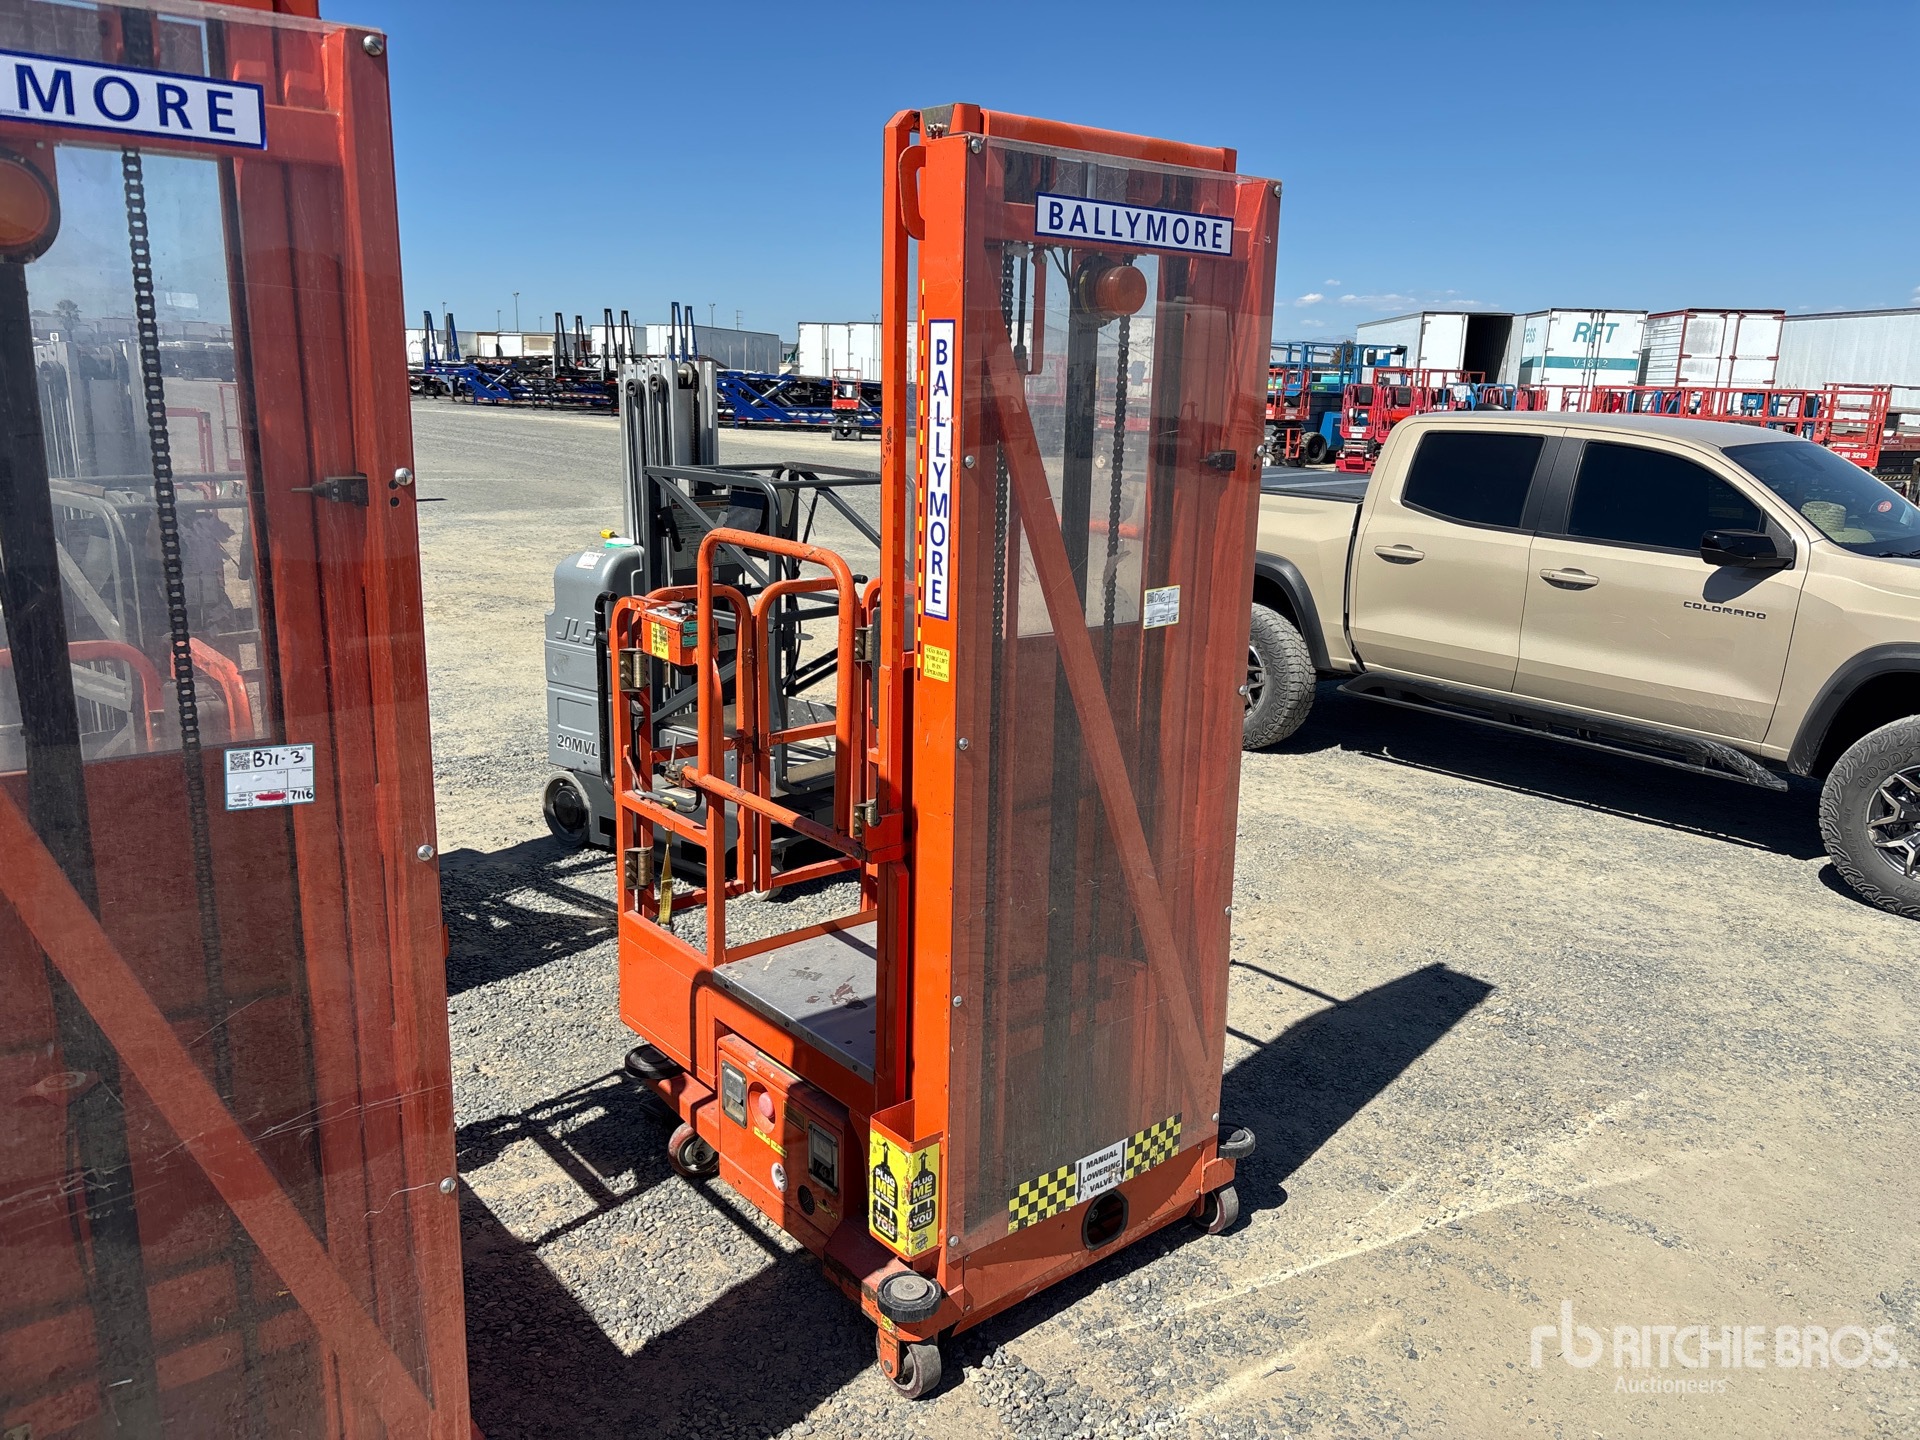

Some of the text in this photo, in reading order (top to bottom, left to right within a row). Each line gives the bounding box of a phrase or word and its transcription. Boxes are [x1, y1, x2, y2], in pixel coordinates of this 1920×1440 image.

[1049, 202, 1223, 248] BALLYMORE
[1572, 322, 1620, 343] RFT
[930, 338, 949, 604] BALLYMORE
[1683, 601, 1767, 619] COLORADO
[555, 616, 596, 646] JLG
[557, 733, 599, 758] 20MVL
[1086, 1149, 1118, 1169] MANUAL
[875, 1168, 895, 1187] PLUG
[913, 1174, 933, 1188] PLUG
[1082, 1160, 1121, 1183] LOWERING
[875, 1176, 895, 1201] ME
[913, 1181, 933, 1200] ME
[1090, 1176, 1112, 1192] VALVE
[875, 1213, 895, 1235] YOU
[913, 1211, 933, 1226] YOU
